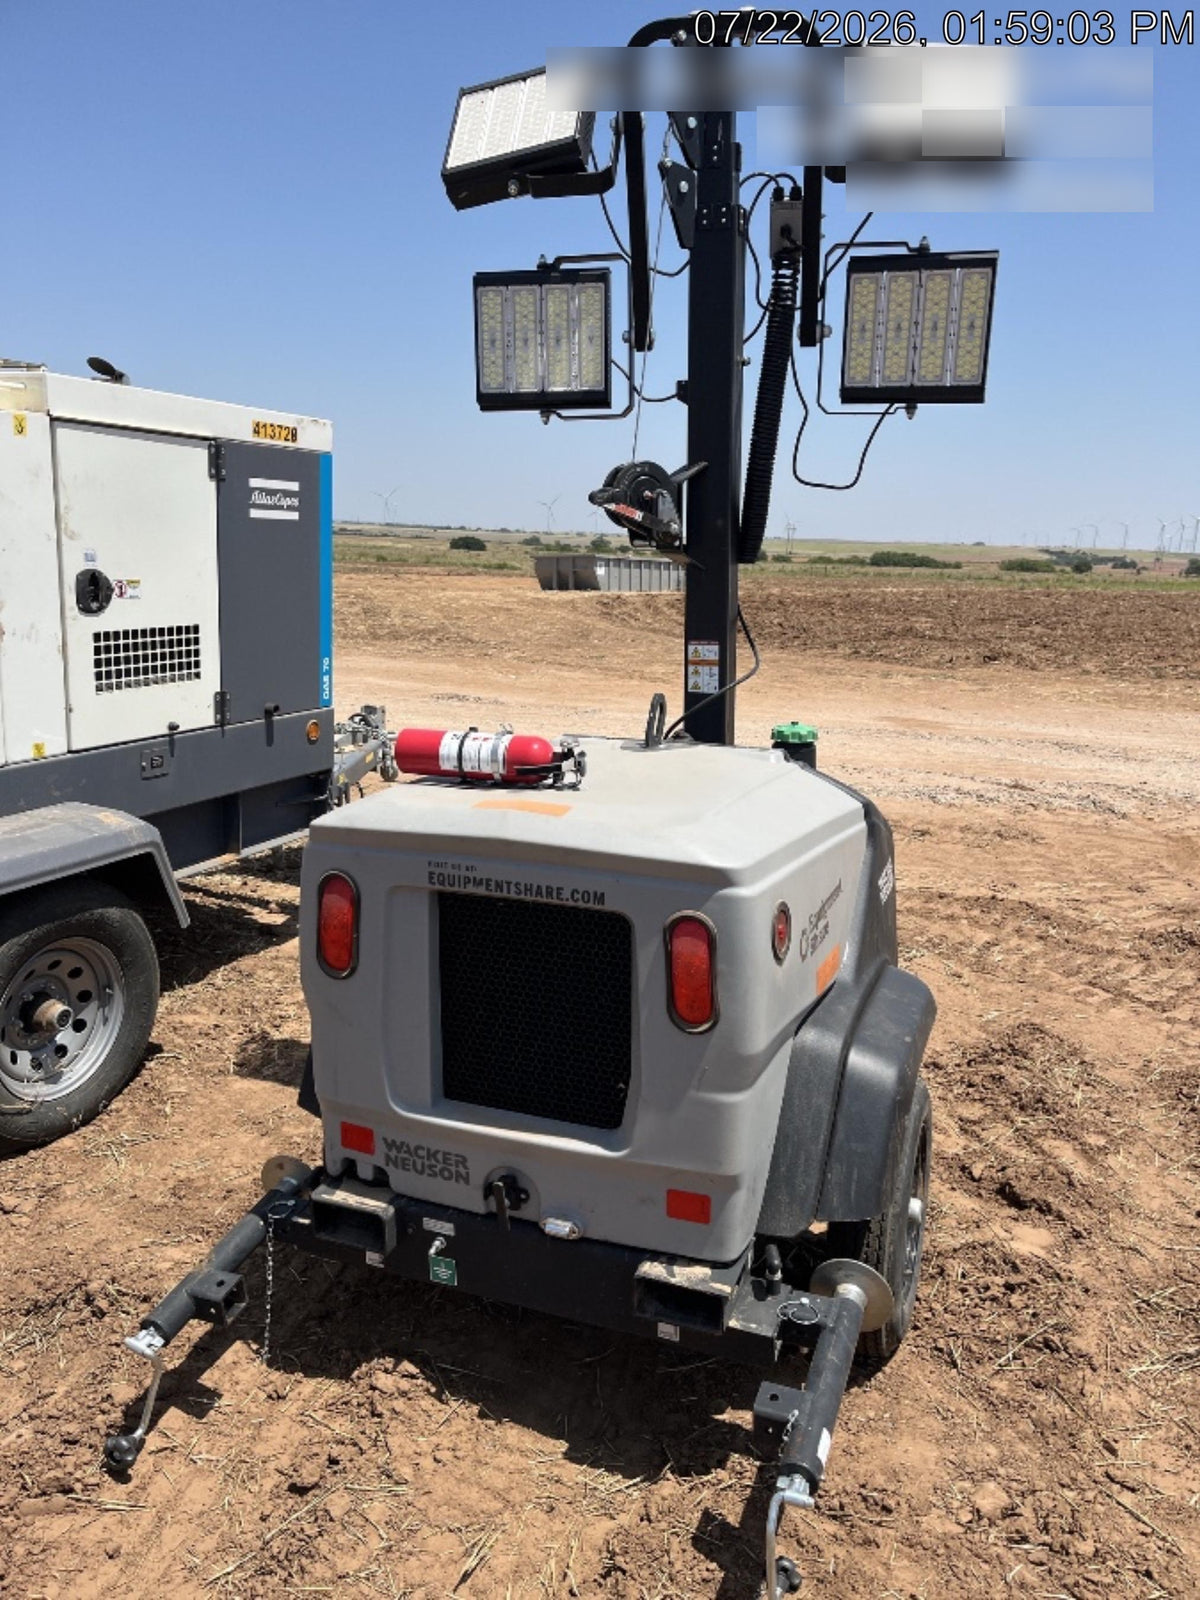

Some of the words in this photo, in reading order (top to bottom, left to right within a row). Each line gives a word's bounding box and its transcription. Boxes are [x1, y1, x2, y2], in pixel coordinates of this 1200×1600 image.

[428, 871, 605, 905] EQUIPMENTSHARE.COM
[382, 1137, 469, 1170] WACKER
[385, 1153, 470, 1185] NEUSON
